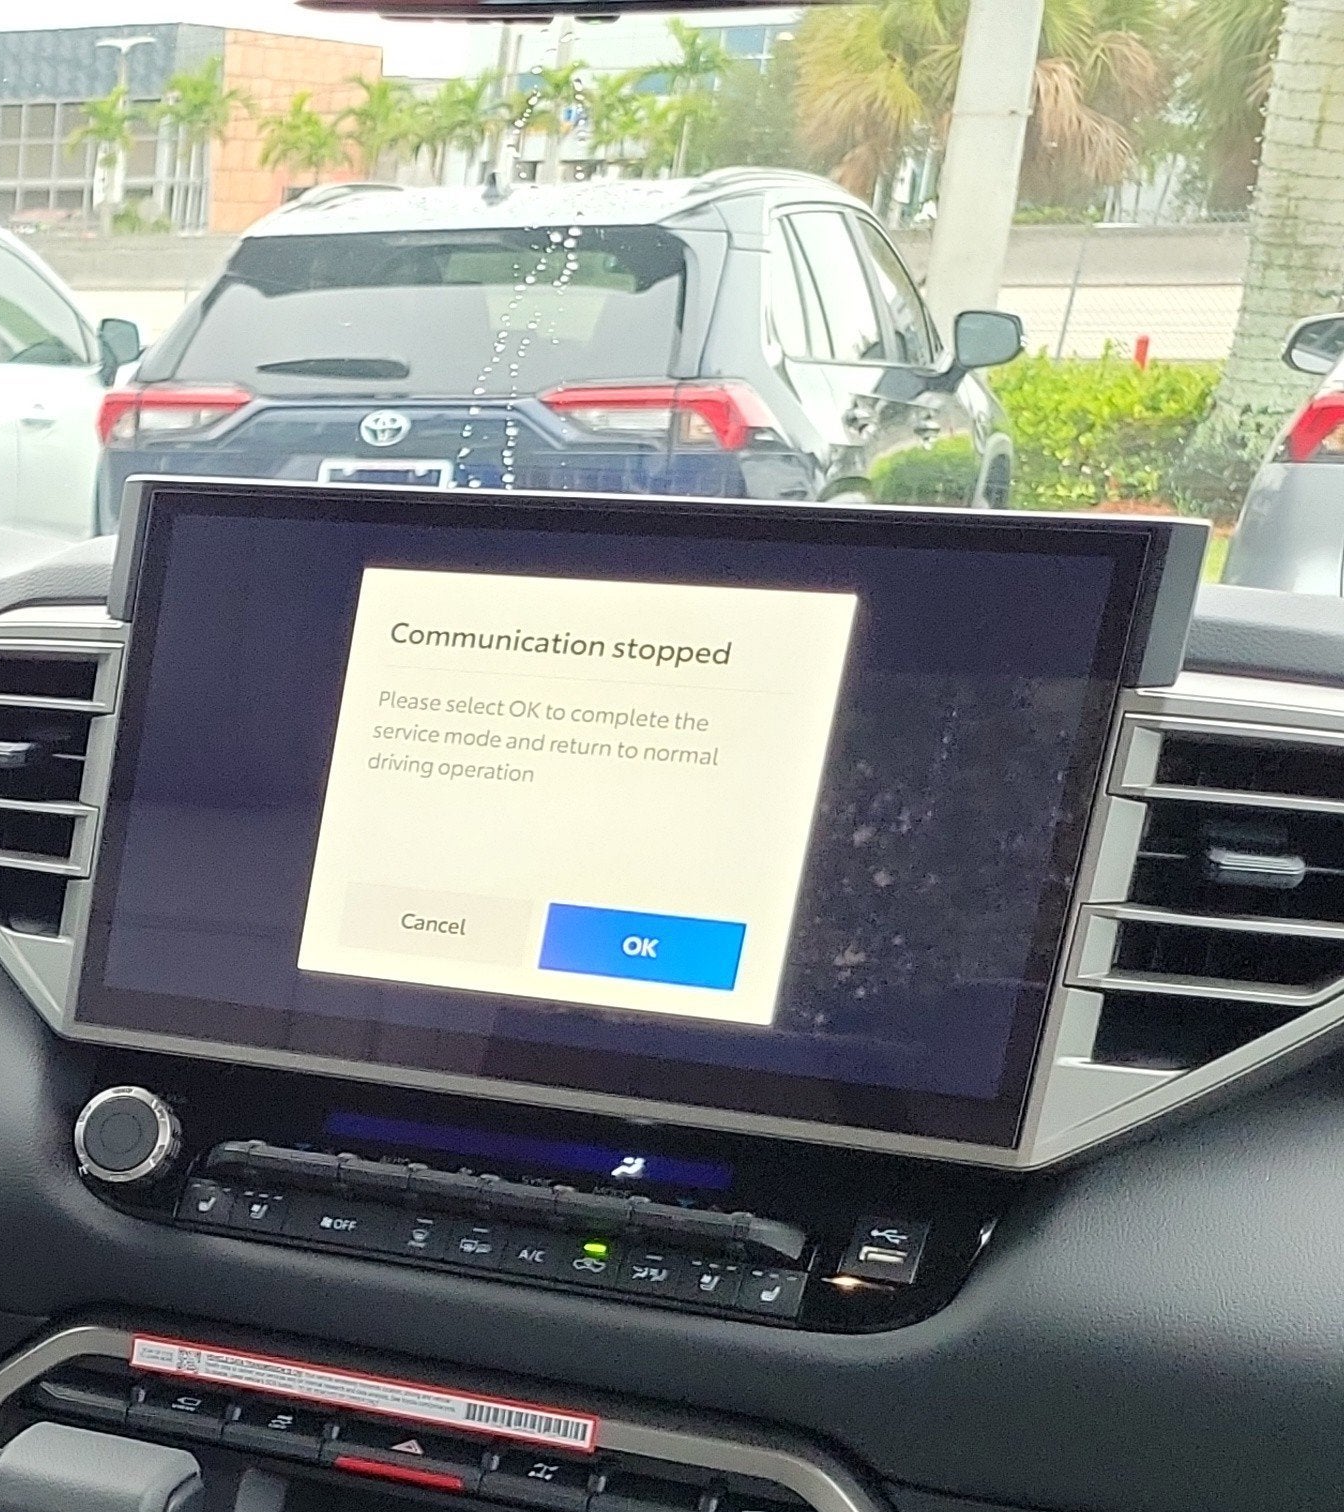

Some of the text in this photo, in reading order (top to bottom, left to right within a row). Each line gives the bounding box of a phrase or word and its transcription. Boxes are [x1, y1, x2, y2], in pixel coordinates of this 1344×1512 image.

[390, 622, 732, 668] Communication stopped
[379, 691, 709, 732] Please select OK to complete the
[373, 723, 720, 766] service mode and return to normal
[367, 753, 535, 786] driving operation
[401, 913, 657, 958] Cancel OK
[332, 1218, 358, 1231] OFF
[518, 1249, 546, 1263] A/C
